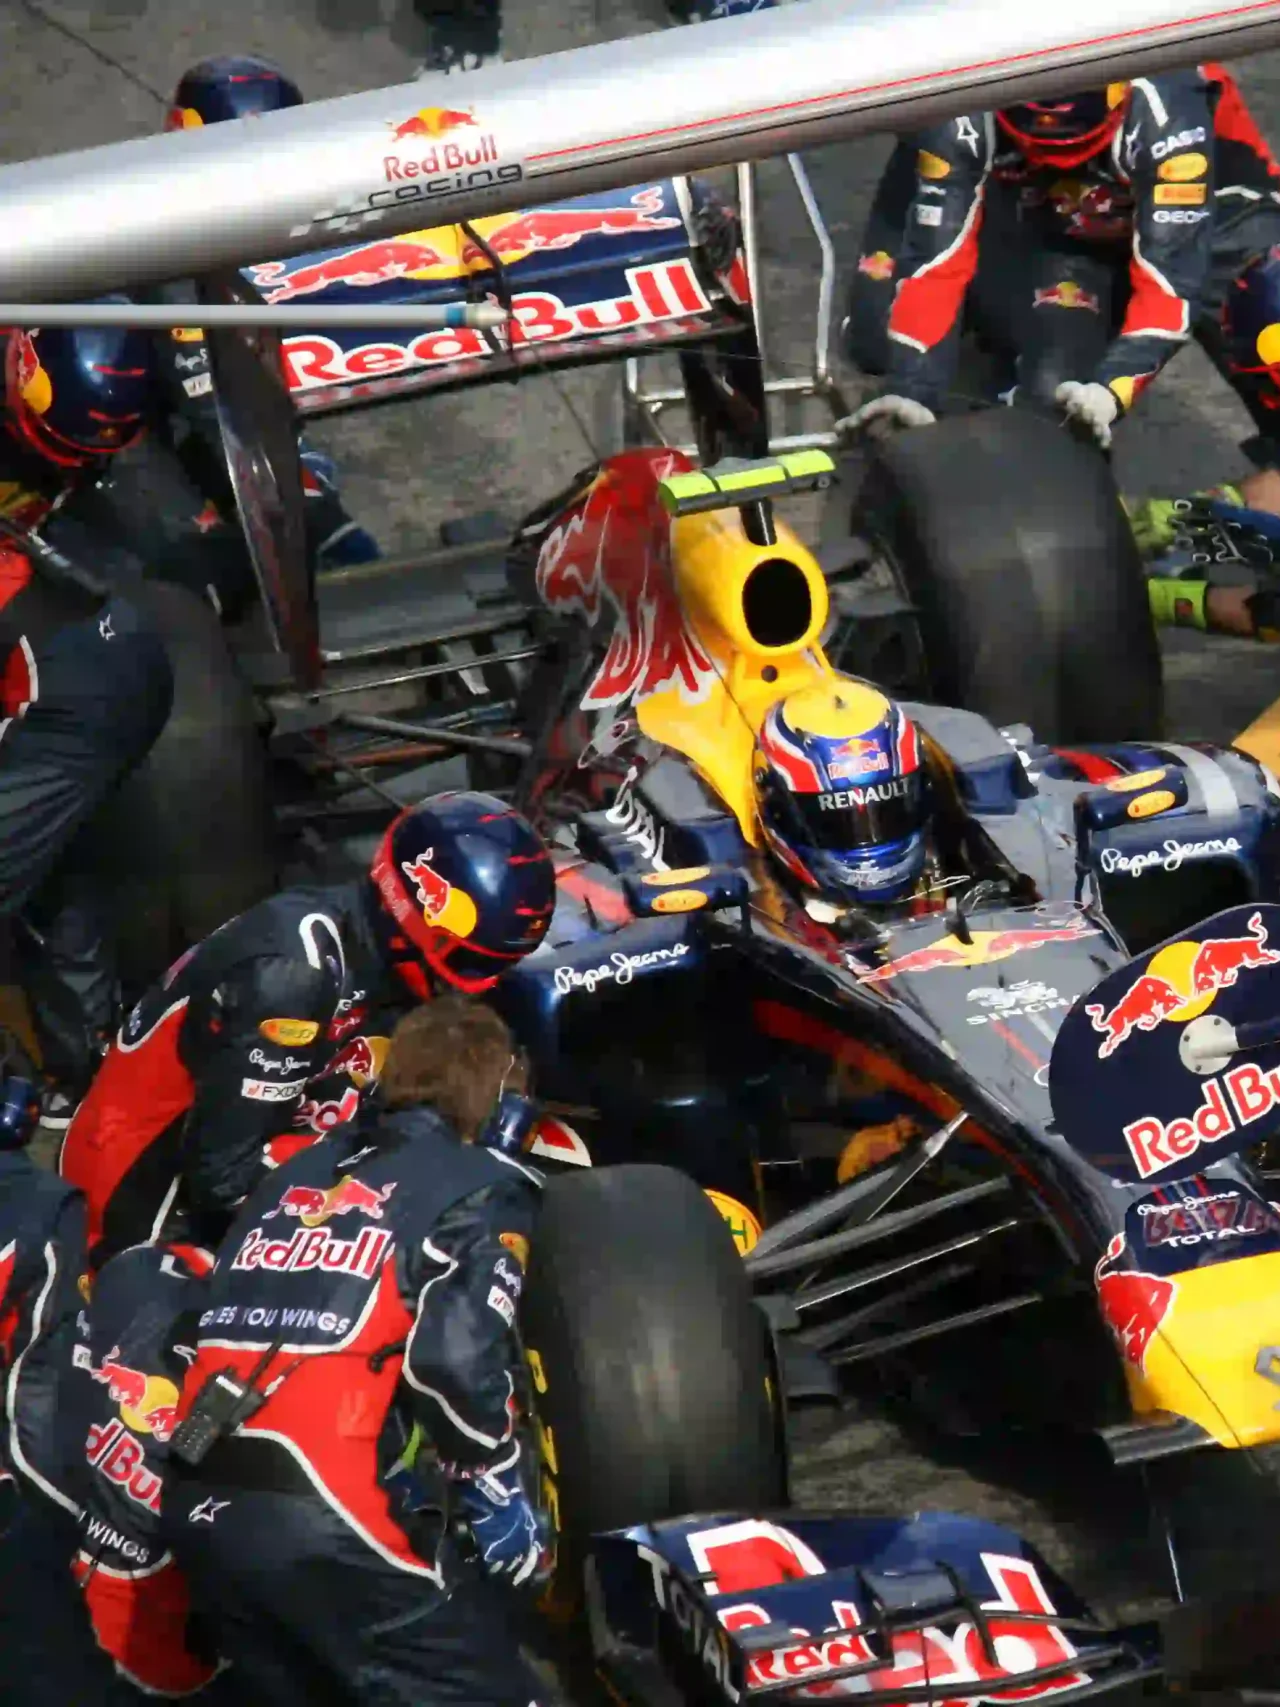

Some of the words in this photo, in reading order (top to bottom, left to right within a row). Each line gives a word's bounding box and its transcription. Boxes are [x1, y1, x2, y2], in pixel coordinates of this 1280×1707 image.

[383, 146, 441, 182] Red
[444, 134, 498, 170] Bull
[368, 163, 523, 207] racing
[281, 327, 491, 392] Red
[502, 258, 712, 347] Bull
[818, 778, 910, 812] RENAULT
[1101, 848, 1164, 878] Pepe
[554, 966, 615, 994] Pepe
[1122, 1078, 1235, 1180] Red
[231, 1228, 302, 1271] Red
[289, 1227, 393, 1280] Bull
[1161, 1224, 1257, 1249] TOTAL
[280, 1307, 353, 1335] WINGS
[100, 1431, 163, 1517] Bu
[86, 1515, 150, 1564] WINGS
